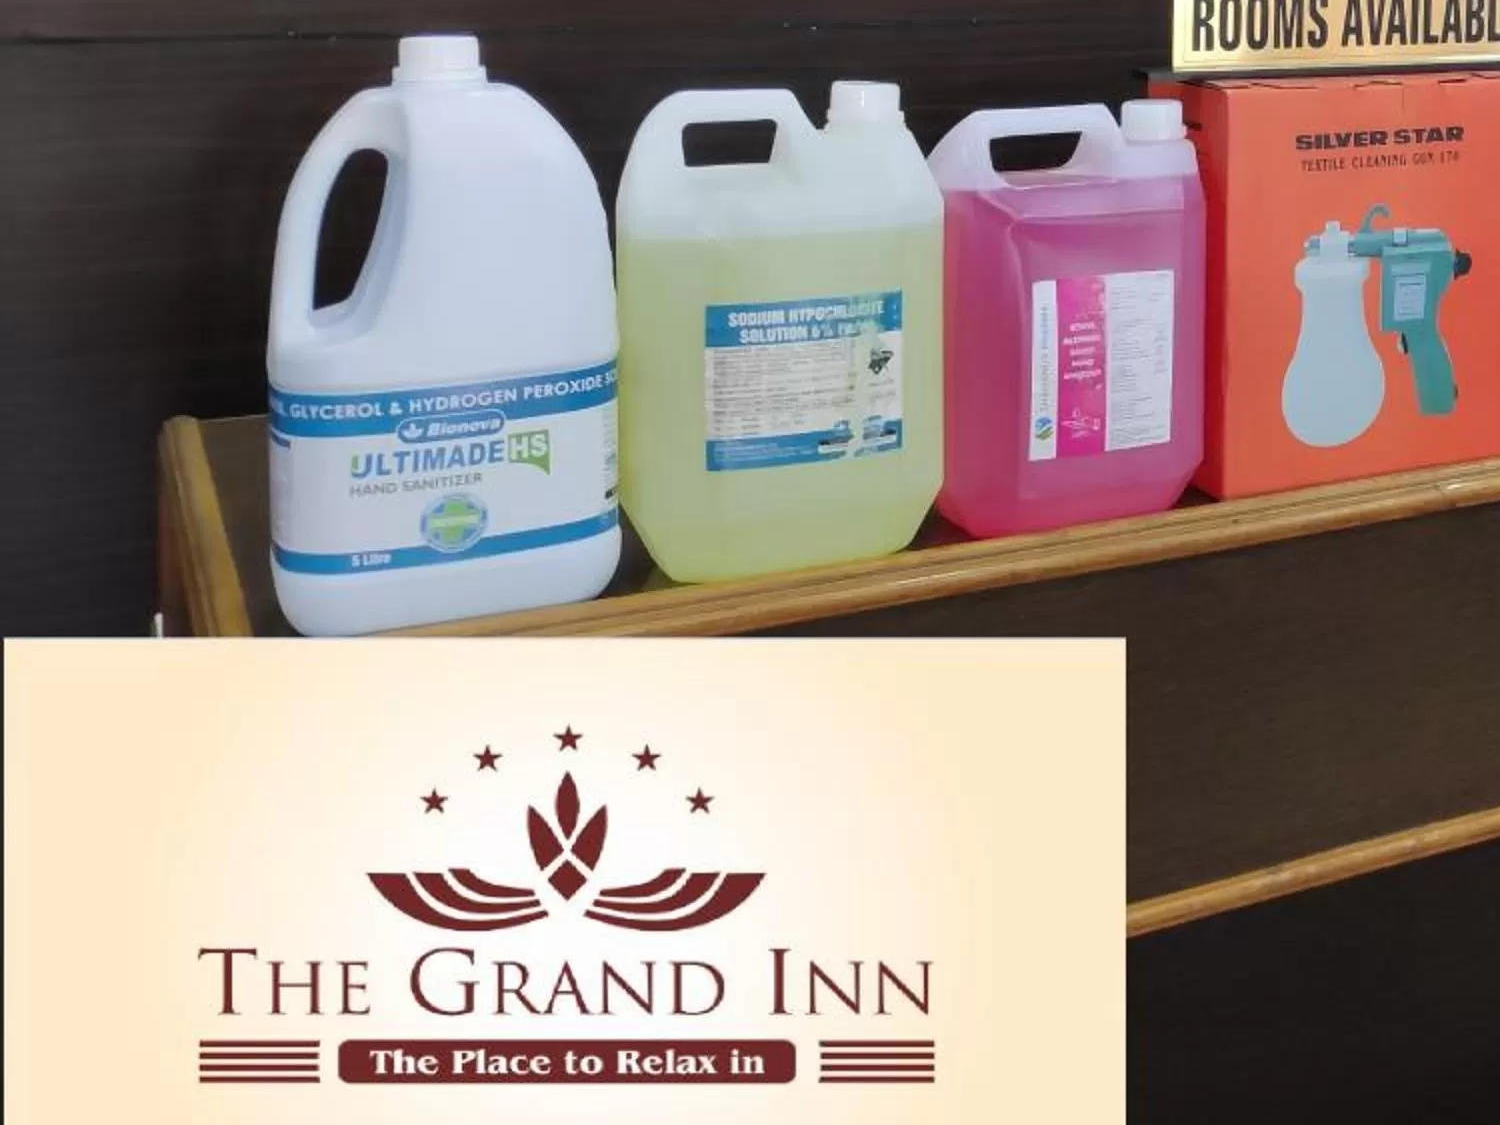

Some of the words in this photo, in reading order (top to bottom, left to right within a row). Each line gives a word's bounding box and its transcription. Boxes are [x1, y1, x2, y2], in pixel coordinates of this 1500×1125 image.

[1295, 130, 1388, 150] SILVER
[1393, 126, 1465, 144] STAR
[1301, 157, 1345, 172] TEXTILE
[1352, 154, 1407, 168] CLEANING
[728, 309, 785, 328] SODIUM
[739, 324, 807, 344] SOLUTION
[289, 402, 384, 420] GLYCEROL
[390, 400, 403, 415] &
[409, 387, 517, 413] HYDROGEN
[523, 375, 602, 400] PEROXIDE
[351, 440, 505, 479] ULTIMADE
[510, 432, 548, 461] HS
[350, 482, 398, 498] HAND
[402, 472, 483, 493] SANITIZER
[352, 554, 361, 567] 5
